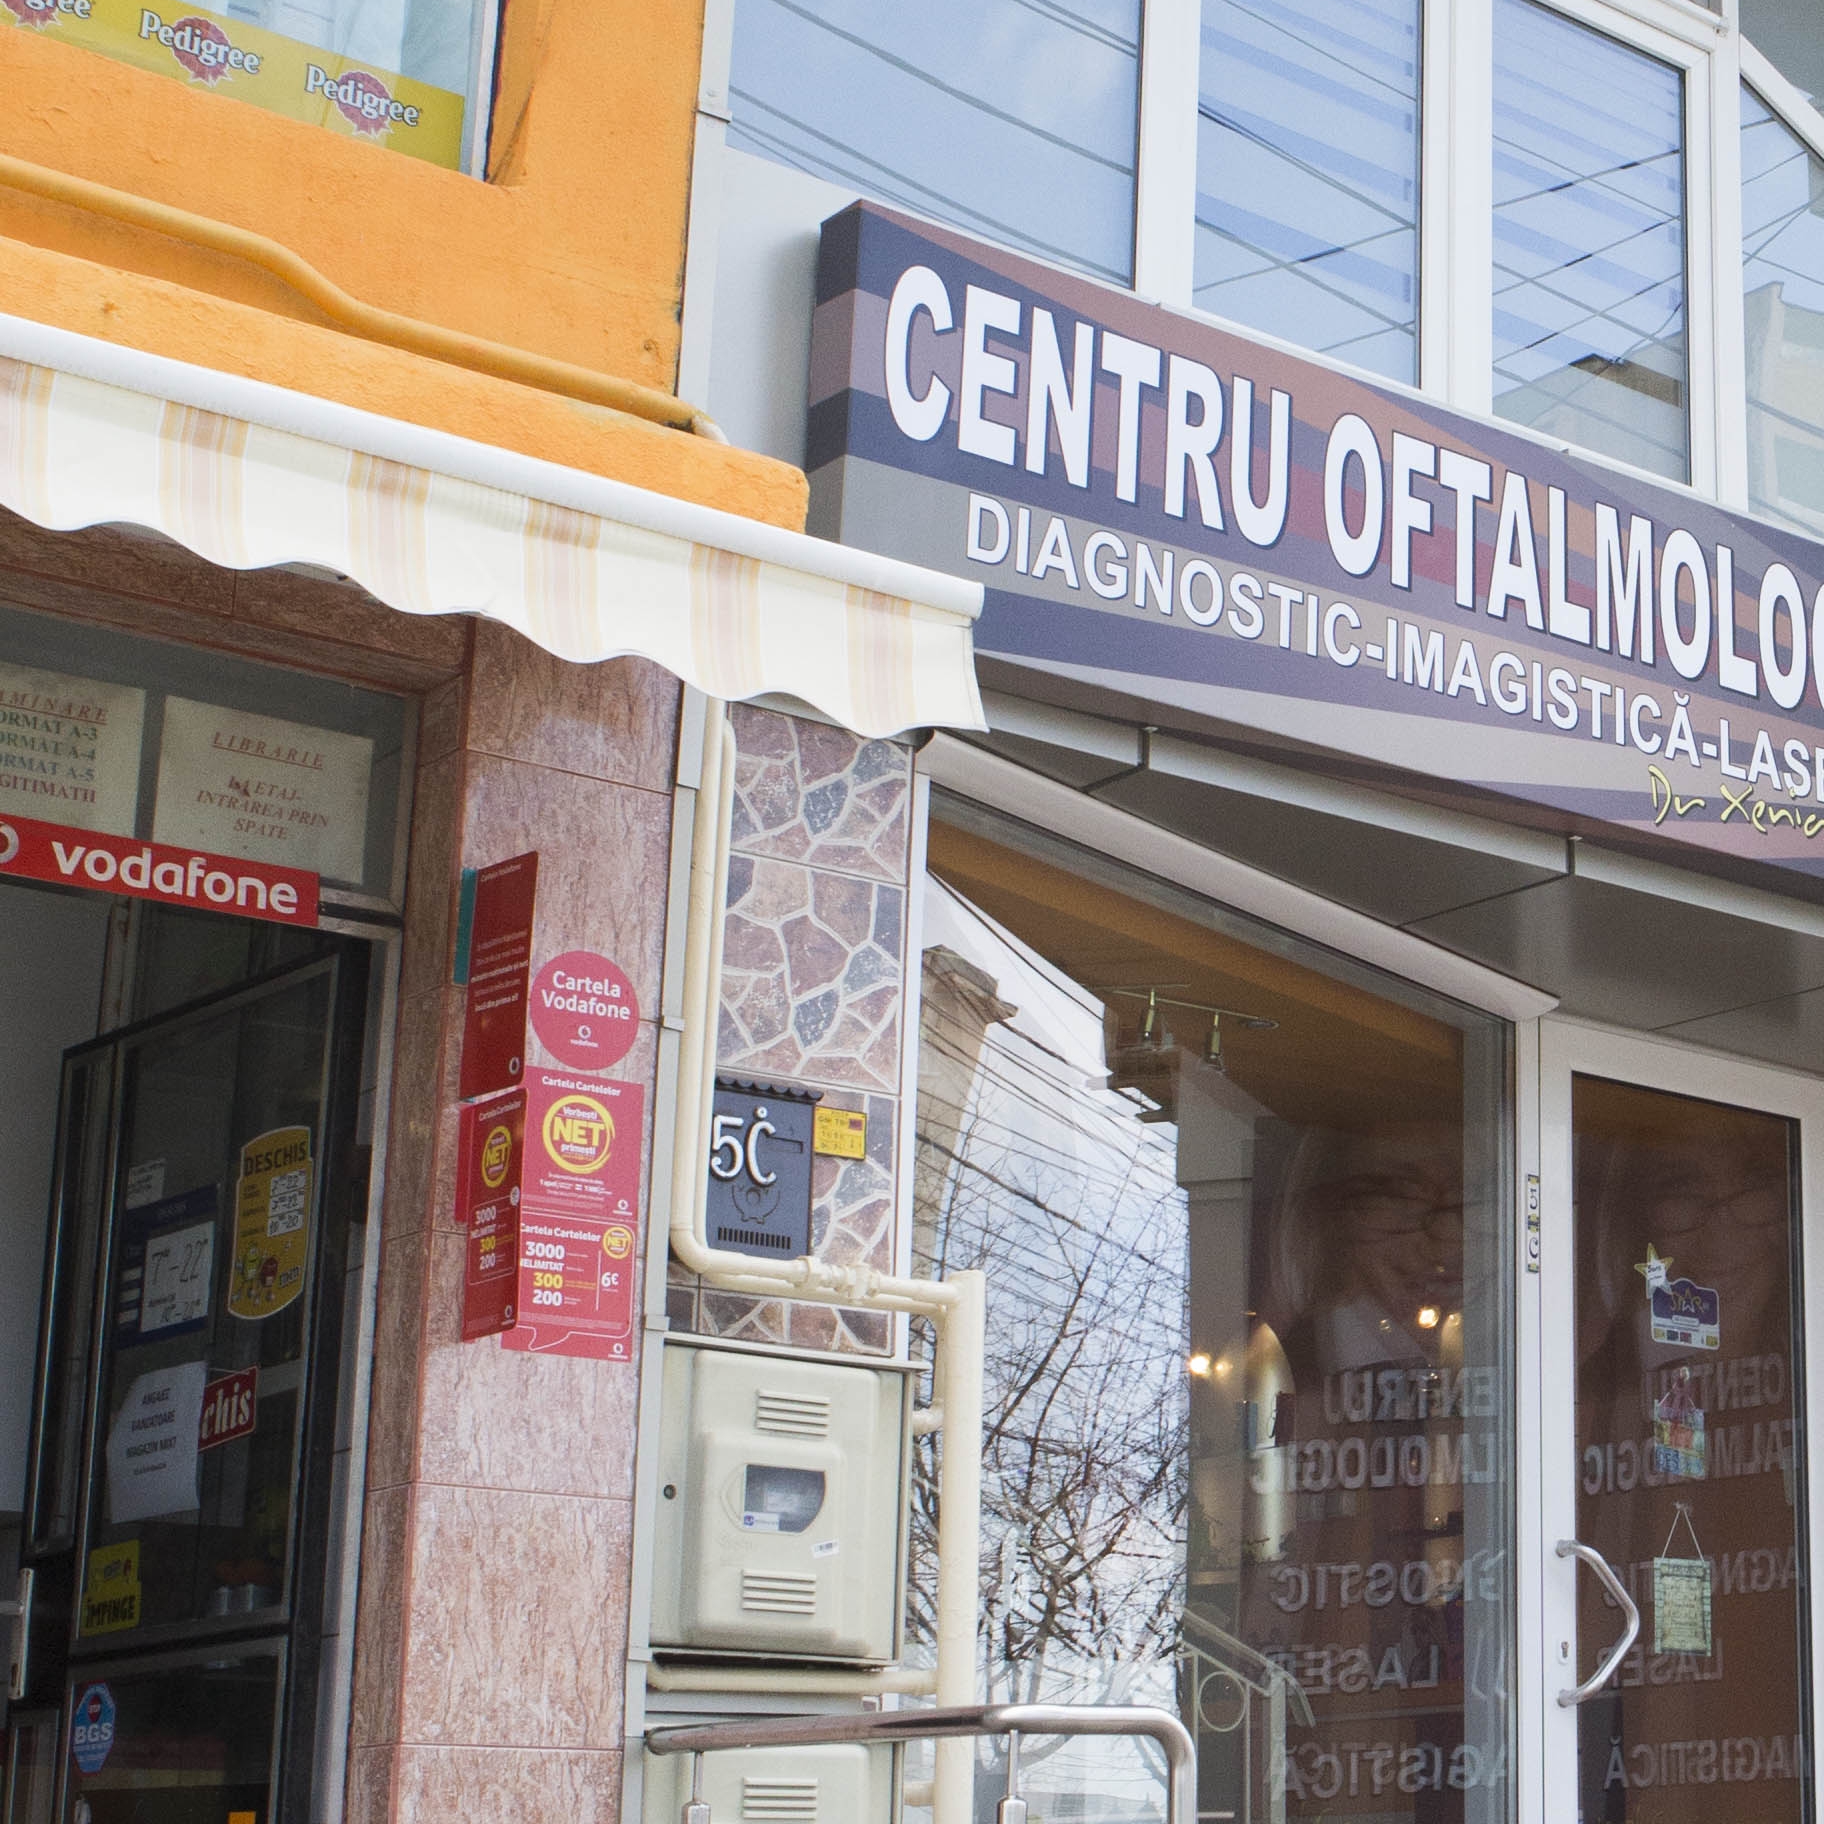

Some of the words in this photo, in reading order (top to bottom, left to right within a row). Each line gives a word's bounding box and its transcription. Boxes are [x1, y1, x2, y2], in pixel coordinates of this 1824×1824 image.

[139, 10, 259, 74] Pedigree
[305, 63, 418, 127] Pedigree
[884, 264, 1292, 548] CENTRU
[212, 732, 326, 766] LIBRARIE
[196, 790, 284, 819] INTRAREA
[287, 809, 330, 827] PRIN
[1648, 764, 1705, 826] Dr
[233, 817, 288, 840] SPATE
[51, 840, 297, 914] vodafone
[552, 970, 622, 999] Cartela
[541, 988, 631, 1020] Vodafone
[542, 1075, 574, 1090] Cartela
[576, 1080, 622, 1096] Cartelelor
[553, 1117, 606, 1147] NET
[245, 1142, 308, 1177] DESCHIS
[486, 1142, 508, 1168] NET
[554, 1227, 602, 1243] Cartelelor
[606, 1236, 629, 1249] NET
[526, 1241, 566, 1260] 3000
[533, 1272, 564, 1289] 300
[601, 1272, 620, 1288] 6€
[532, 1288, 563, 1307] 200
[75, 1722, 112, 1744] BGS
